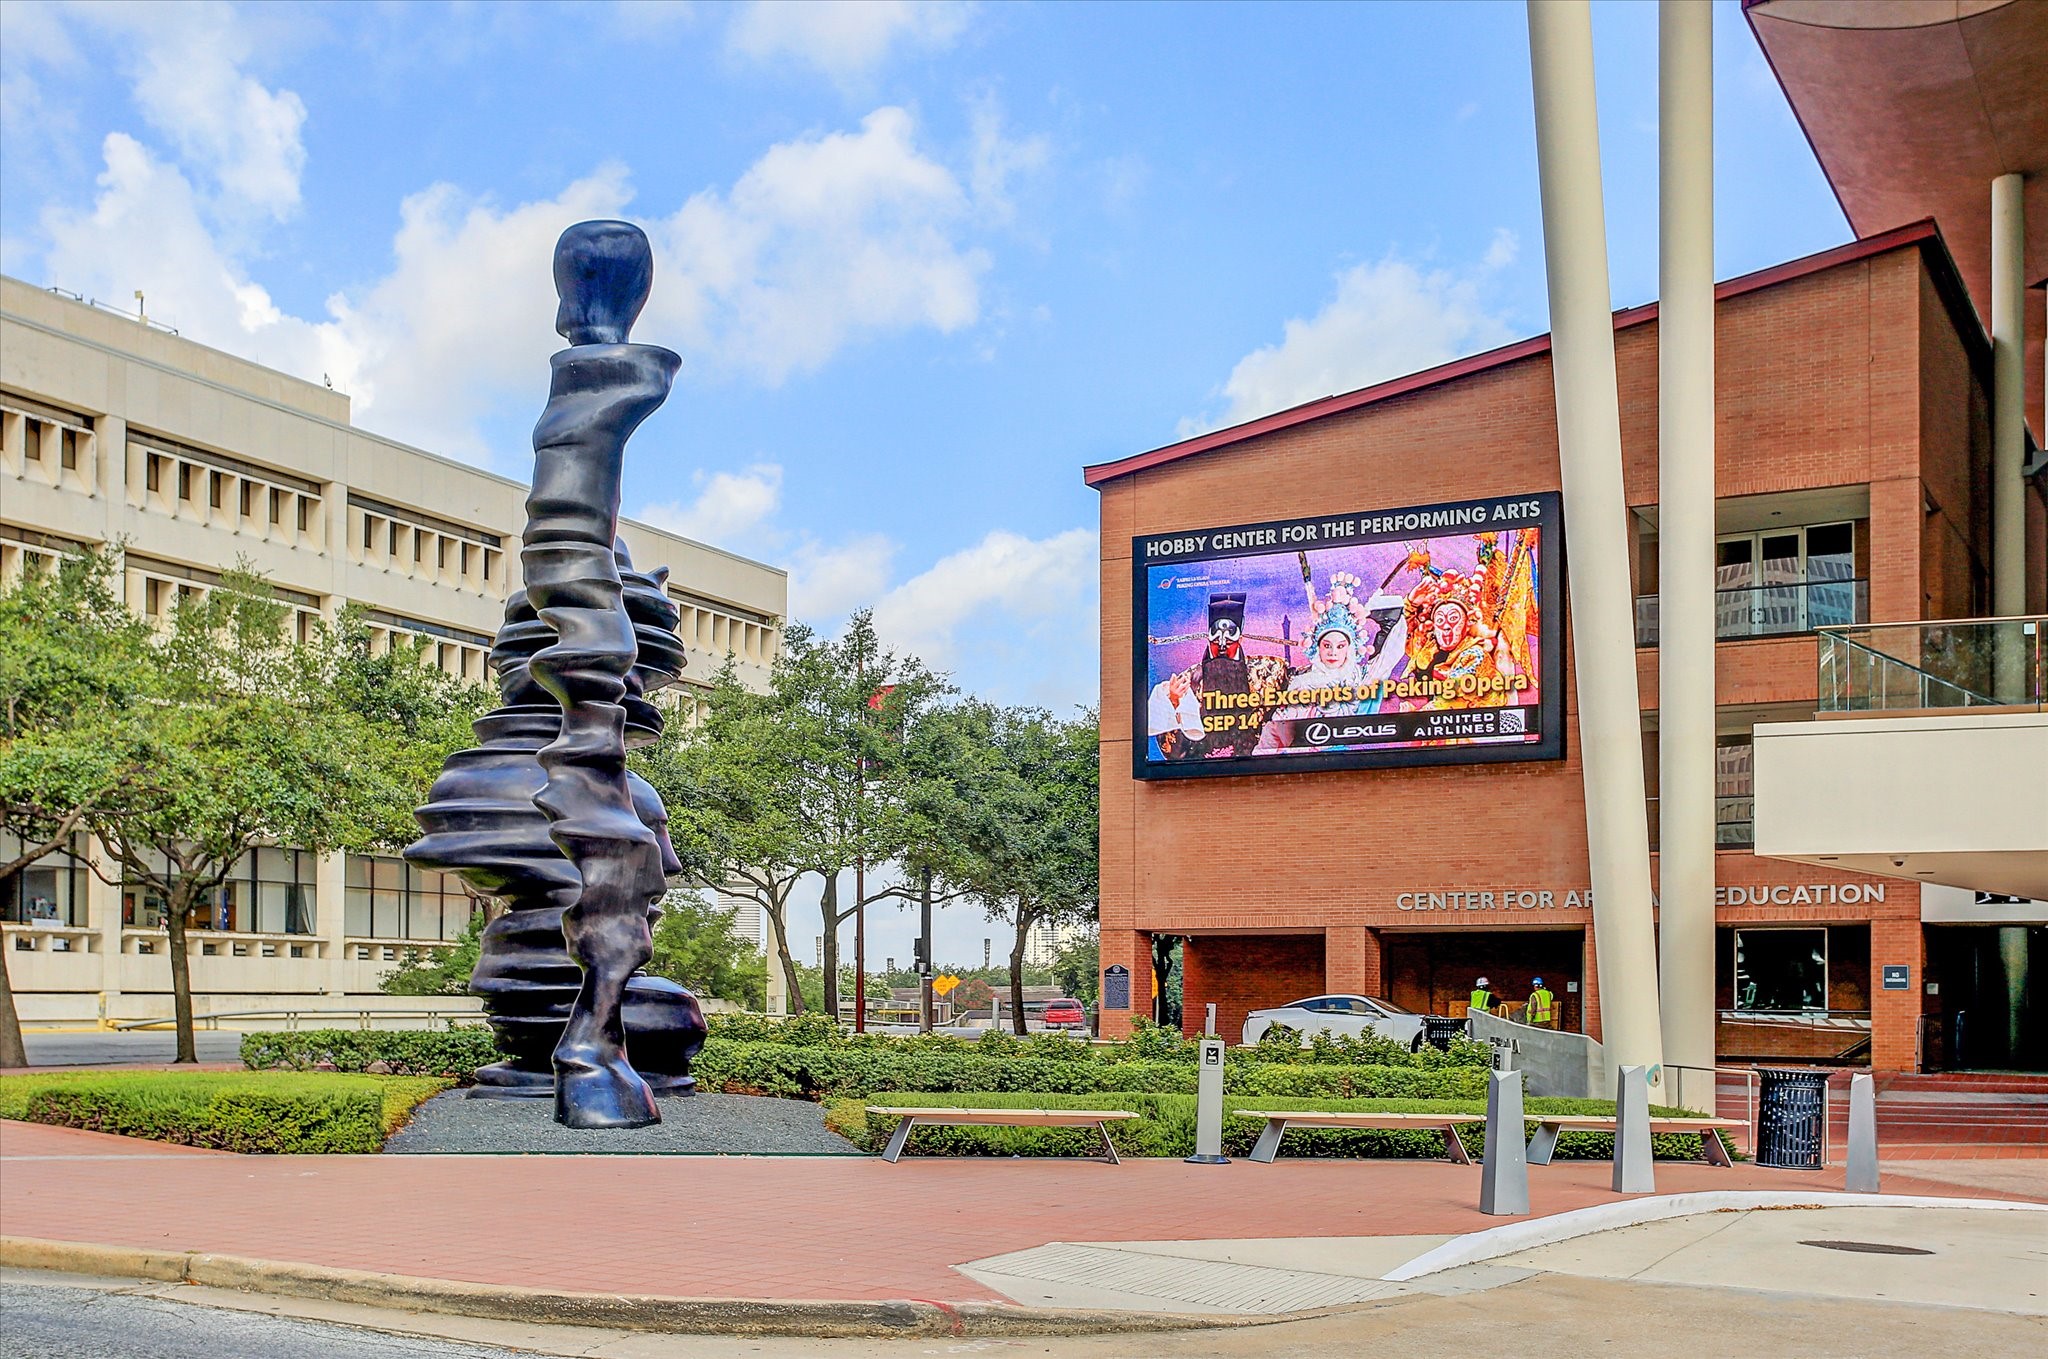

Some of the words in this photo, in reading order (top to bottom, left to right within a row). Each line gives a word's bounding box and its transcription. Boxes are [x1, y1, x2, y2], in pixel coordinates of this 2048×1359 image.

[1146, 536, 1207, 557] HOBBY
[1211, 529, 1277, 550] CENTER
[1281, 524, 1318, 543] FOR
[1322, 520, 1355, 538] THE
[1360, 506, 1486, 535] PERFORMING
[1491, 500, 1541, 521] ARTS
[1203, 690, 1260, 710] Three
[1264, 684, 1352, 707] Excerpts
[1357, 680, 1380, 700] of
[1383, 675, 1456, 699] Peking
[1460, 673, 1528, 697] Opera
[1203, 715, 1236, 732] SEP
[1238, 713, 1259, 730] 14
[1430, 712, 1495, 725] UNITED
[1333, 723, 1397, 739] LEXUS
[1414, 723, 1495, 737] AIRLINES
[1396, 891, 1496, 911] CENTER
[1503, 890, 1555, 909] FOR
[1715, 883, 1885, 906] EDUCATION
